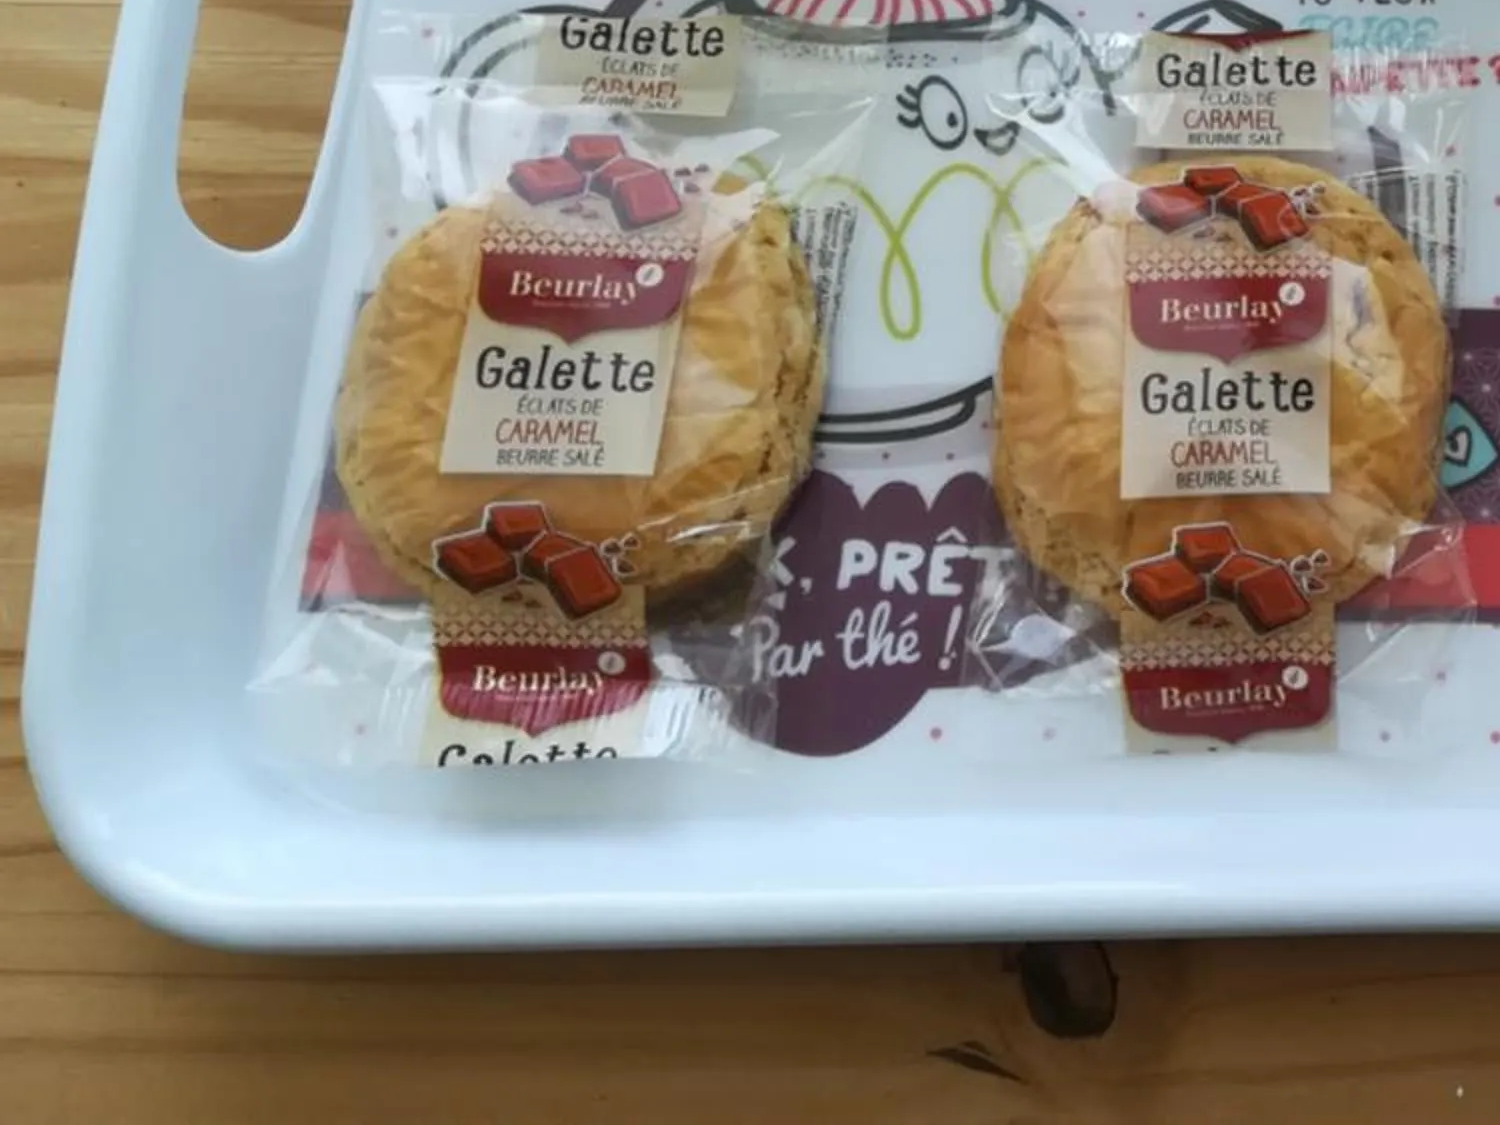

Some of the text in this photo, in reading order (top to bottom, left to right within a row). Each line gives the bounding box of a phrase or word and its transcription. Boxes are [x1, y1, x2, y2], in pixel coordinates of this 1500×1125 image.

[560, 16, 725, 58] Galette
[1156, 53, 1317, 88] Galette
[1183, 109, 1281, 132] CARAMEL
[508, 269, 639, 306] Beurlay
[1160, 293, 1286, 325] Beurlay
[475, 345, 656, 392] Galette
[517, 395, 604, 415] ÉCLATS DE
[1141, 368, 1317, 414] Galette
[494, 418, 604, 446] CARAMEL
[1187, 417, 1271, 436] ÉCLATS DE
[496, 446, 606, 467] BEURRE SALÉ
[1170, 440, 1275, 466] CARAMEL
[1176, 466, 1282, 490] BEURRE SALÉ
[750, 600, 963, 683] Par thé !
[1160, 677, 1289, 710] Beurlay
